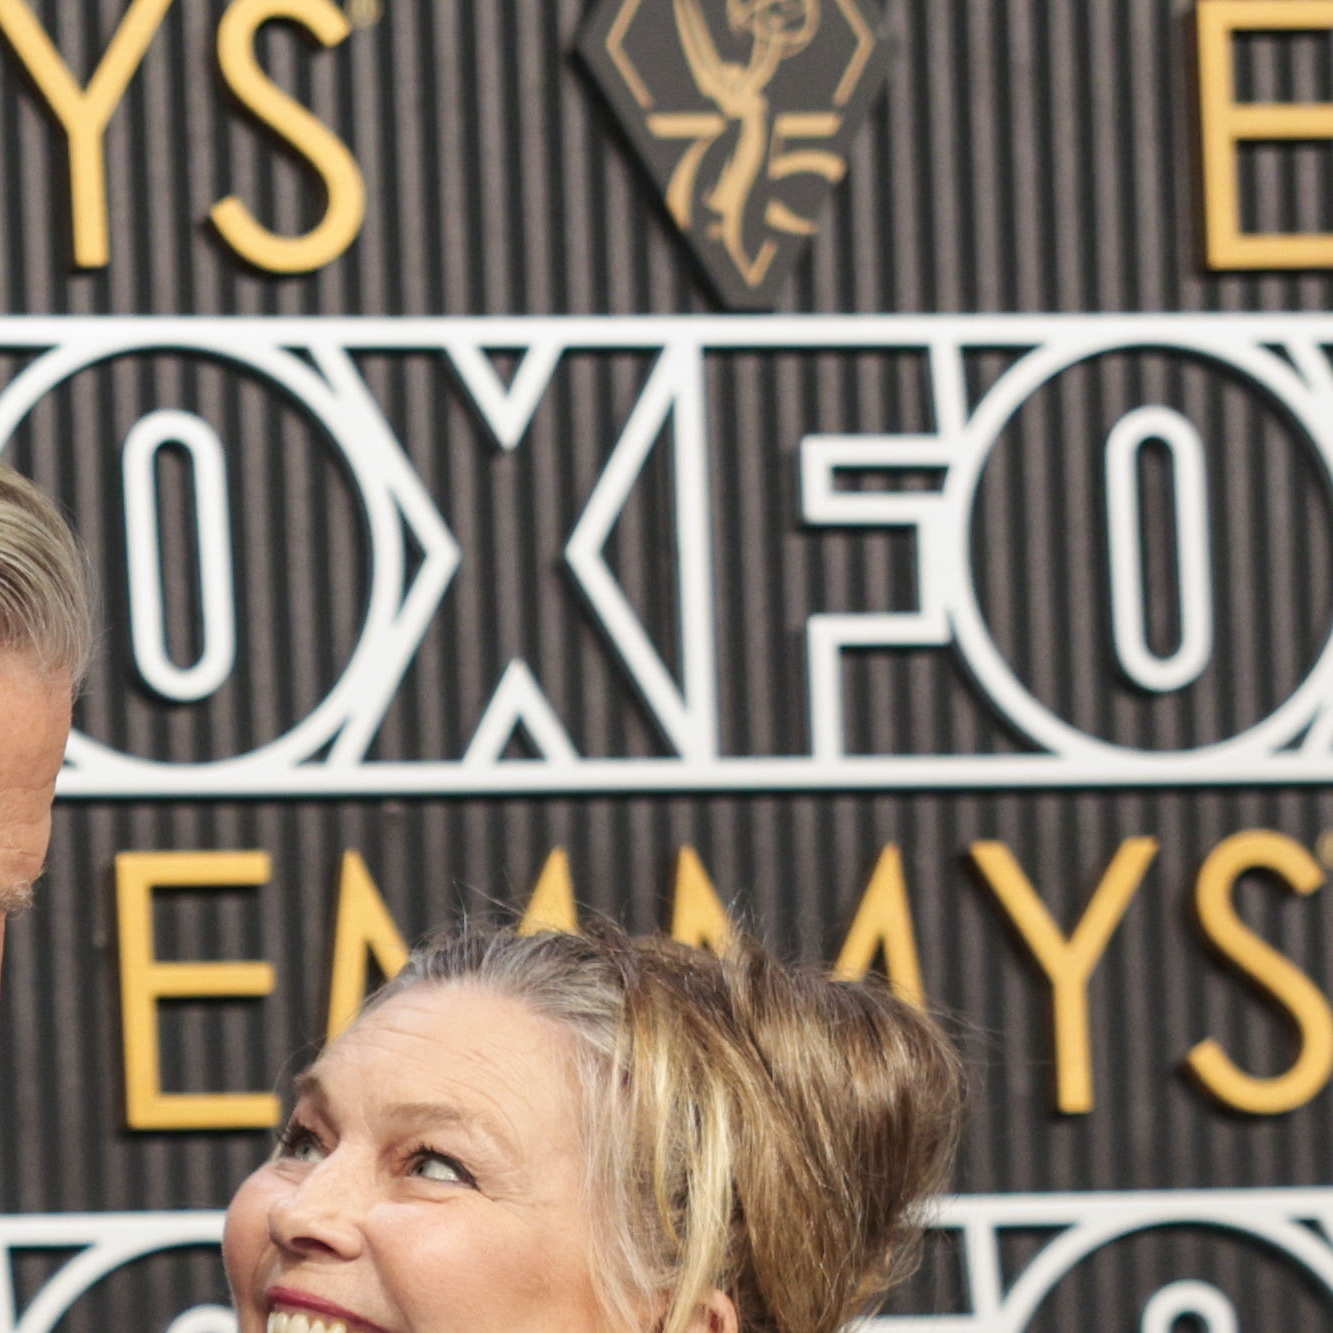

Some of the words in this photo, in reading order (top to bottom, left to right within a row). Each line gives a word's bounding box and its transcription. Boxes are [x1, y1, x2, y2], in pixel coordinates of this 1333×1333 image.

[646, 112, 847, 236] 75
[674, 313, 1333, 792] FO
[116, 829, 1333, 1130] EYS
